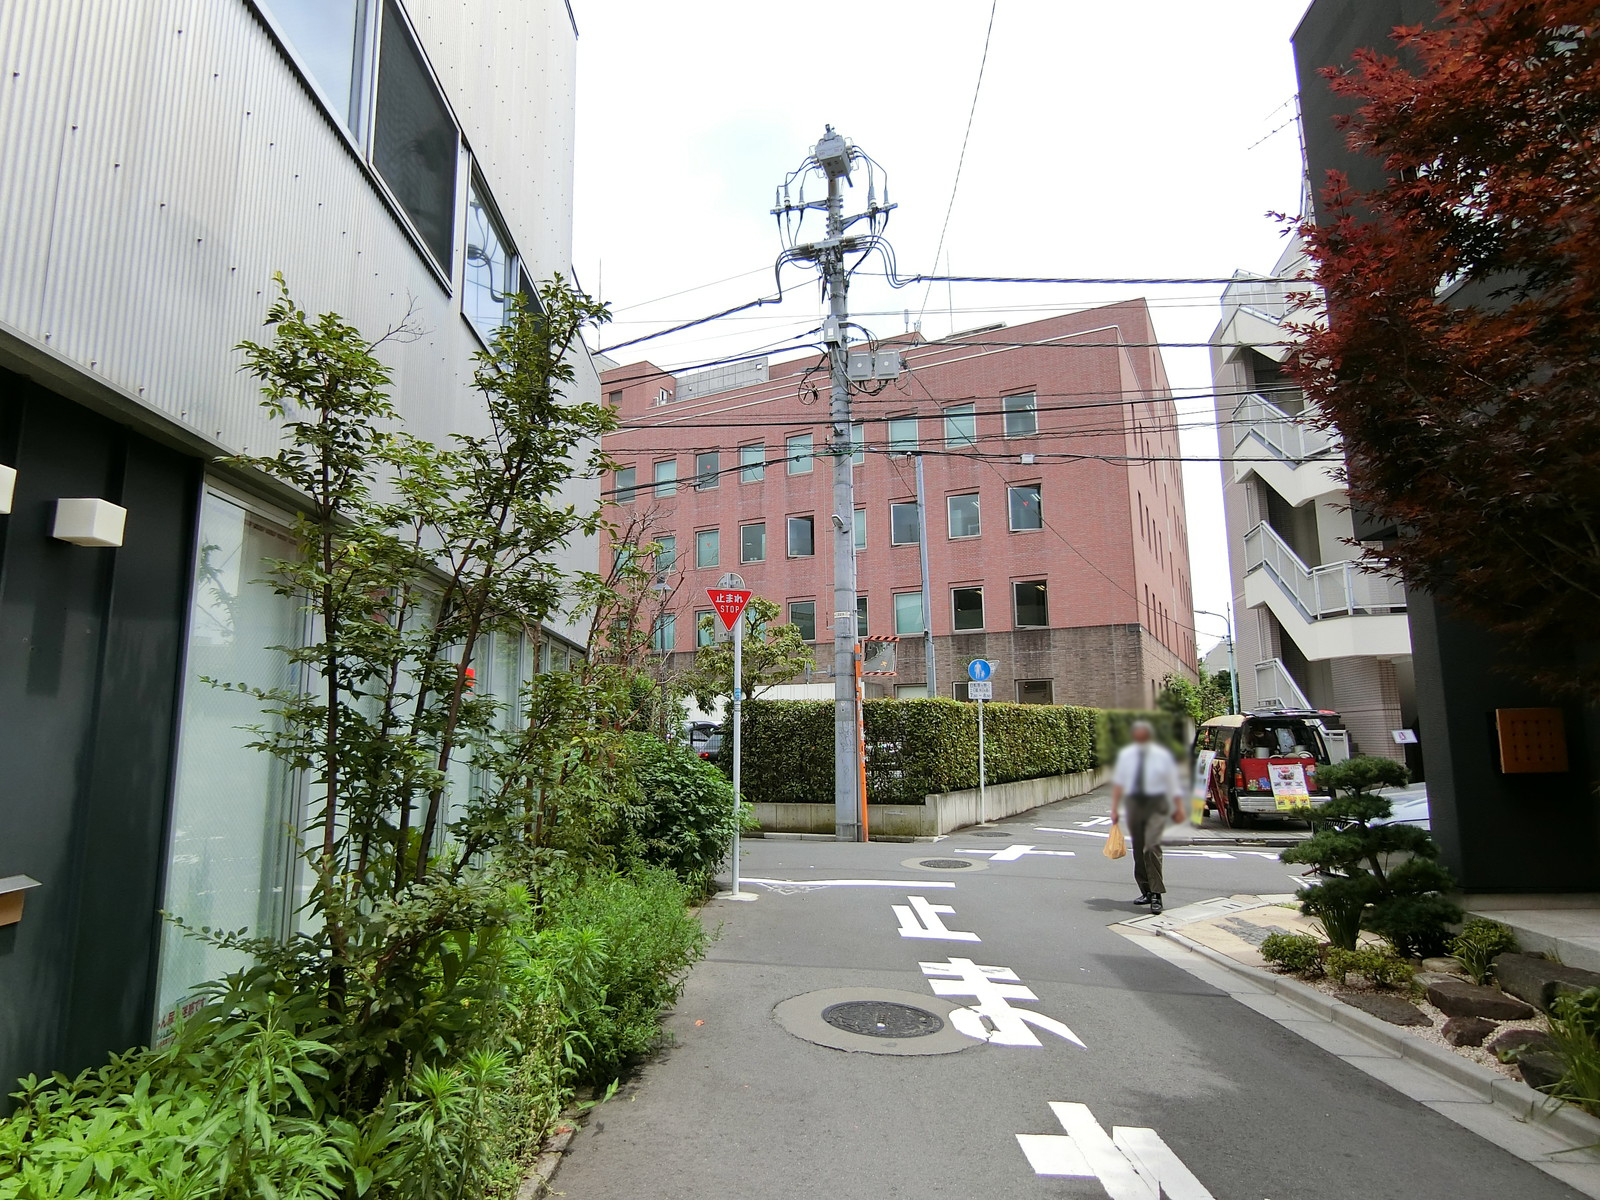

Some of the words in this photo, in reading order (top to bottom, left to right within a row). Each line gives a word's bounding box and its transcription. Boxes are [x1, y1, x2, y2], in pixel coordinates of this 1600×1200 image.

[716, 593, 743, 603] 止まれ
[720, 605, 740, 613] STOP
